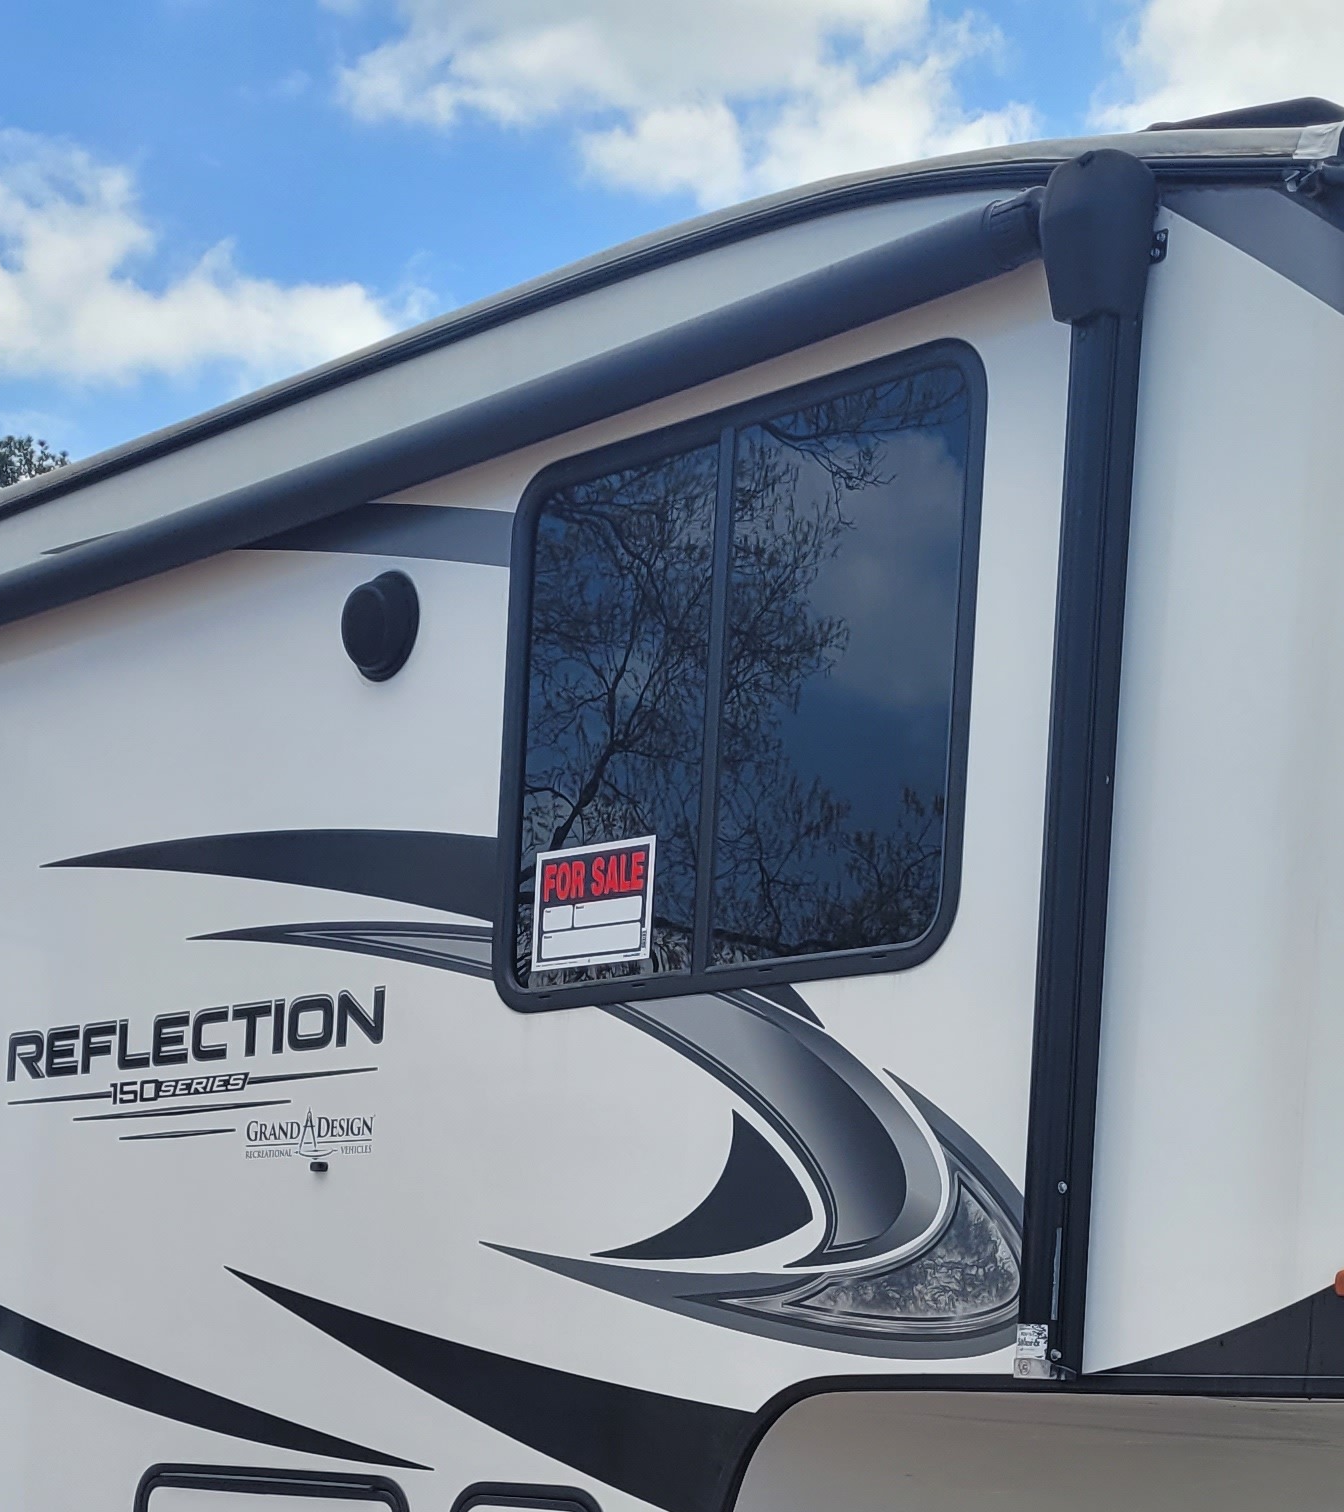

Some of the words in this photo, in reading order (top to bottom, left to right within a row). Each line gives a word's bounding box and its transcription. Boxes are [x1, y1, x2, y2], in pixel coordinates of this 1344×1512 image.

[544, 861, 586, 902] FOR
[591, 851, 646, 896] SALE
[7, 985, 387, 1082] REFLECTION
[246, 1120, 301, 1142] GRAND
[317, 1116, 374, 1138] DESIGN
[245, 1149, 292, 1159] RECREATIONAL
[340, 1144, 372, 1155] VEHICLES
